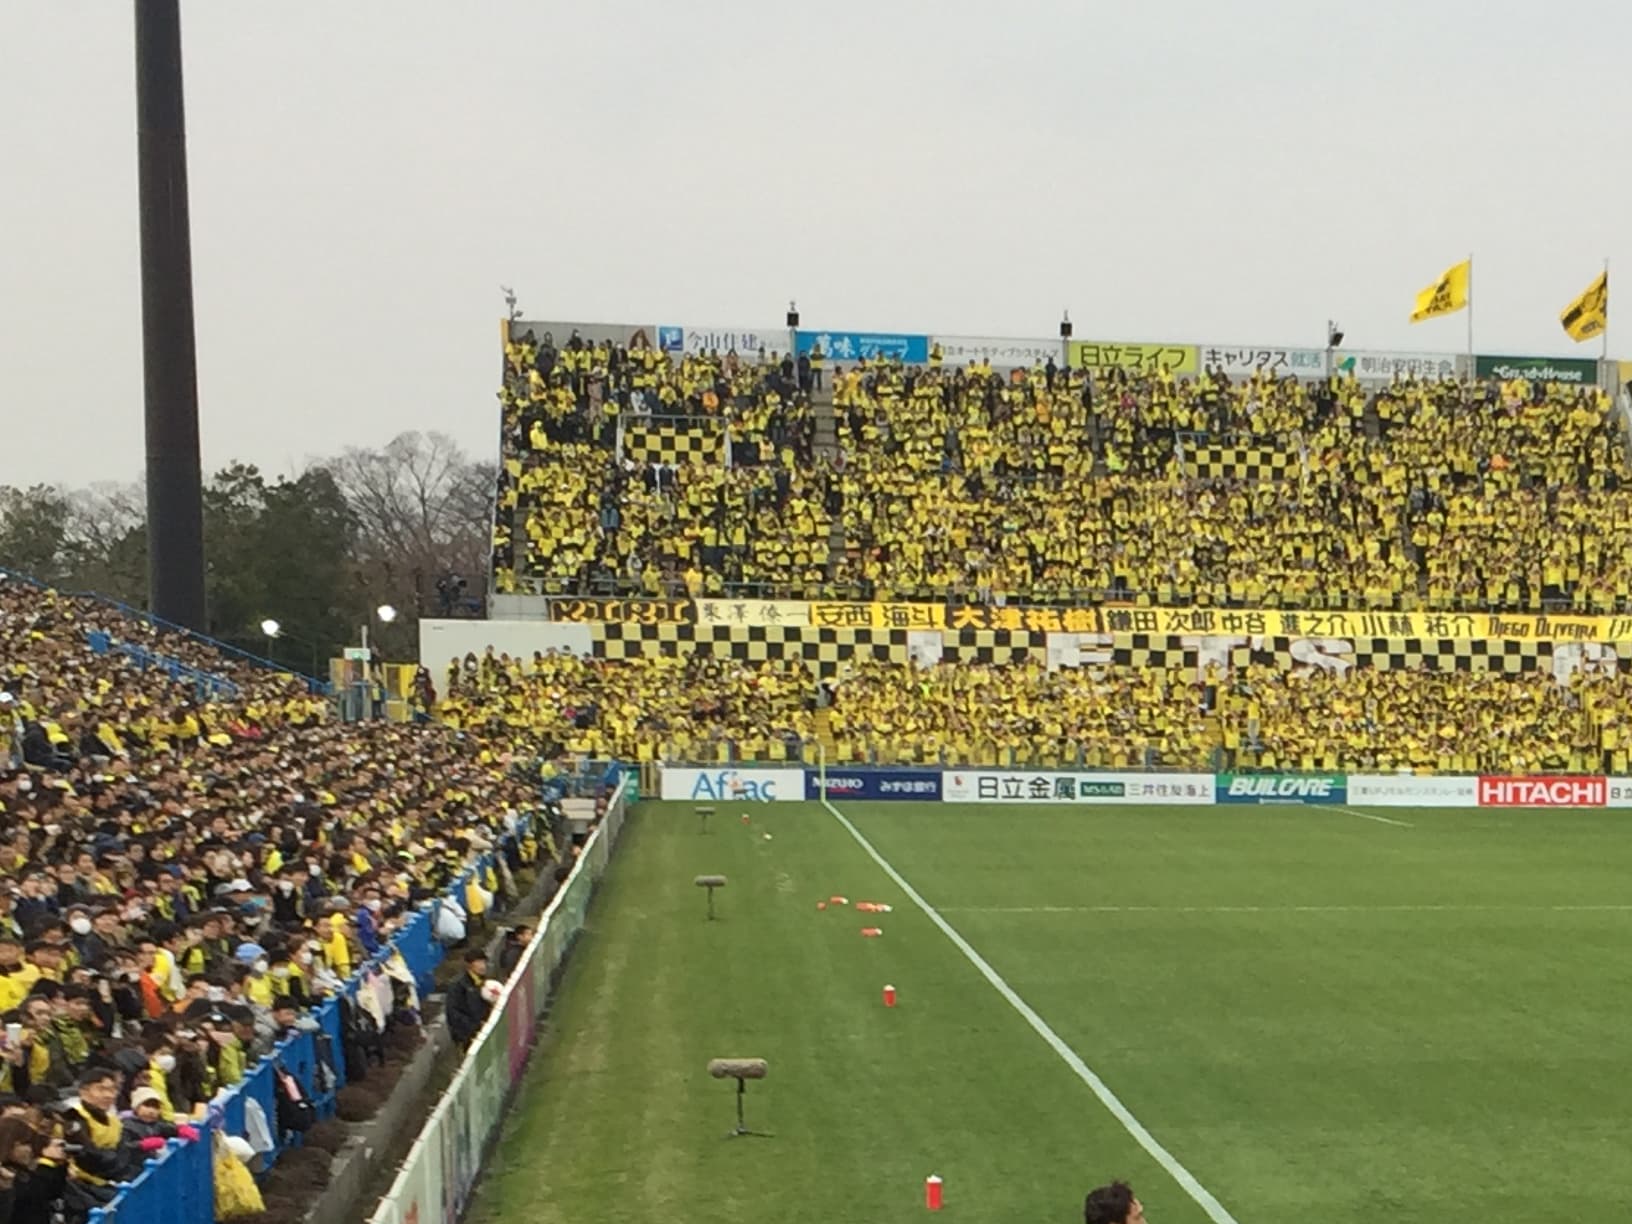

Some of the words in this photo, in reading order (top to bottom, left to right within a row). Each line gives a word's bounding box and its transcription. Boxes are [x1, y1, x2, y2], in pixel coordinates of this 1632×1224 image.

[1080, 345, 1187, 370] 日立ライフ
[977, 776, 1076, 800] 日立金属
[1228, 777, 1334, 797] BUILCARE
[1482, 781, 1604, 804] HITACHI
